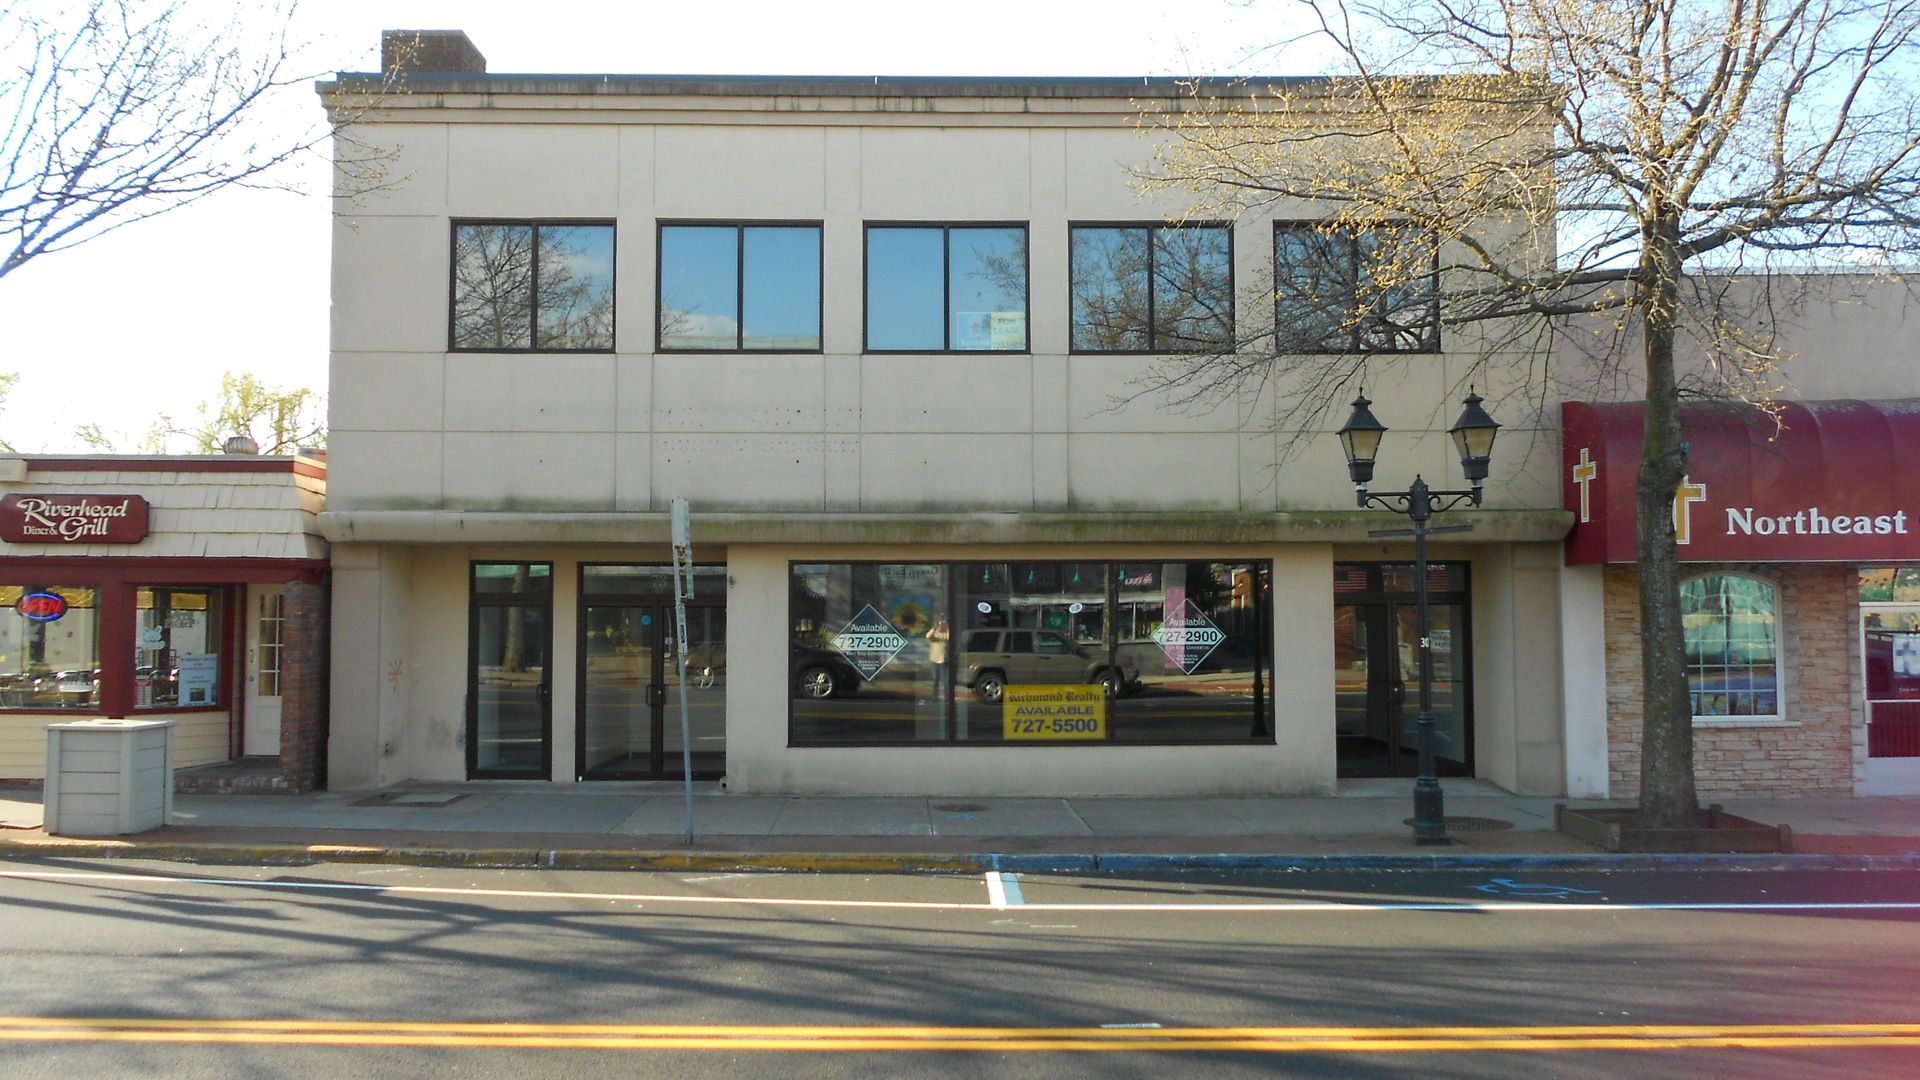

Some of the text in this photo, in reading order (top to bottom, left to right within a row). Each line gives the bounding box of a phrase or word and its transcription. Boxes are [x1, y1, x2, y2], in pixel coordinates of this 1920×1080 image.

[16, 498, 129, 527] Riverhead
[1725, 507, 1908, 535] Northeast
[23, 526, 49, 535] Diner
[59, 516, 109, 541] Grill
[18, 597, 63, 615] OPEN
[850, 623, 888, 632] Available
[1168, 617, 1206, 626] Available
[839, 636, 900, 648] 727-2900
[1157, 630, 1218, 642] 727-2900
[1008, 691, 1100, 704] Richmond Realty
[1016, 706, 1094, 715] AVAILABLE
[1012, 718, 1098, 733] 727-5500
